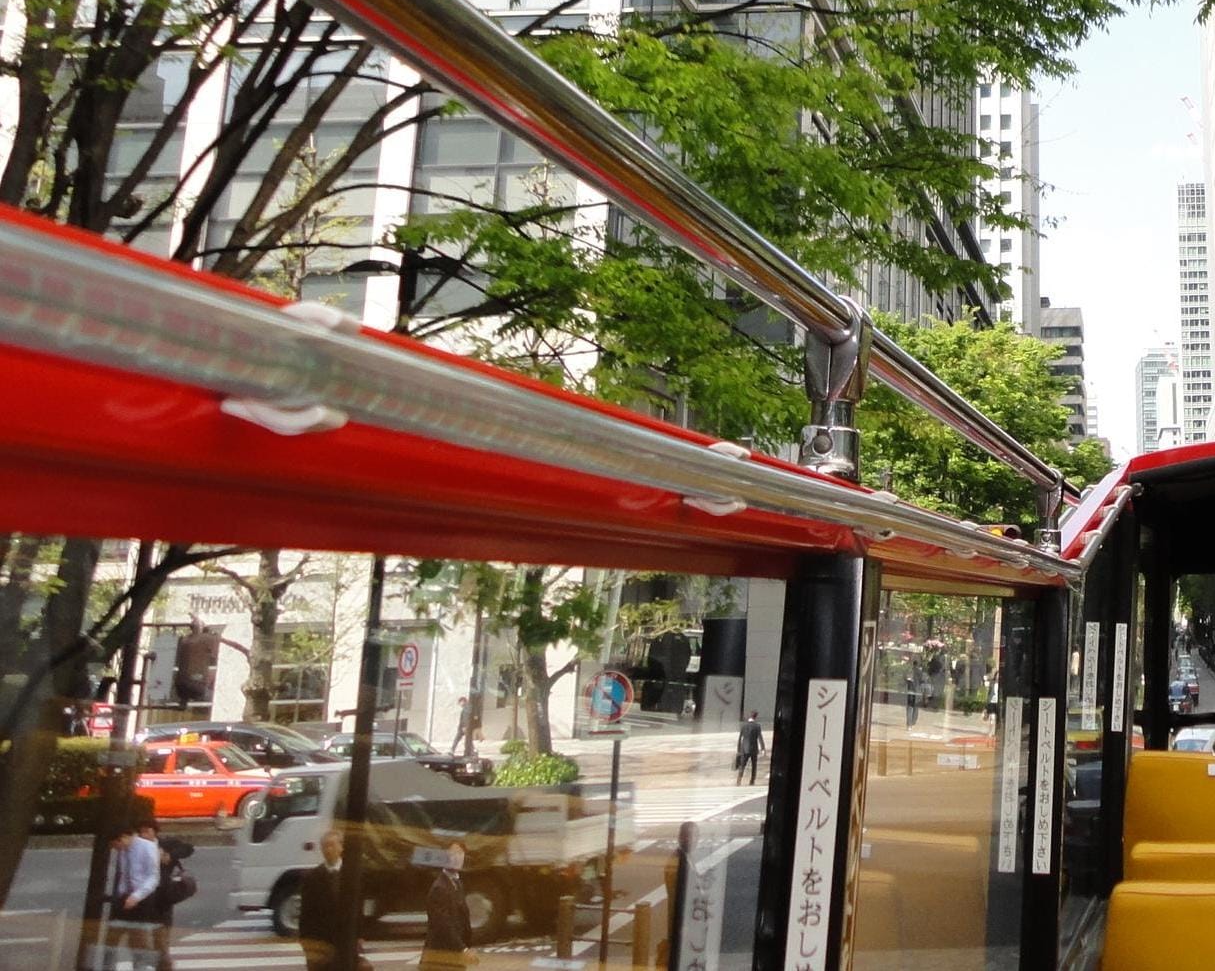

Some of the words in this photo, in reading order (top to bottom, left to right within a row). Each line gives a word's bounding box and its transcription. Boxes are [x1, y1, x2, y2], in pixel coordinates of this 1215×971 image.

[1036, 701, 1053, 870] シートベルトをおしめ下さい
